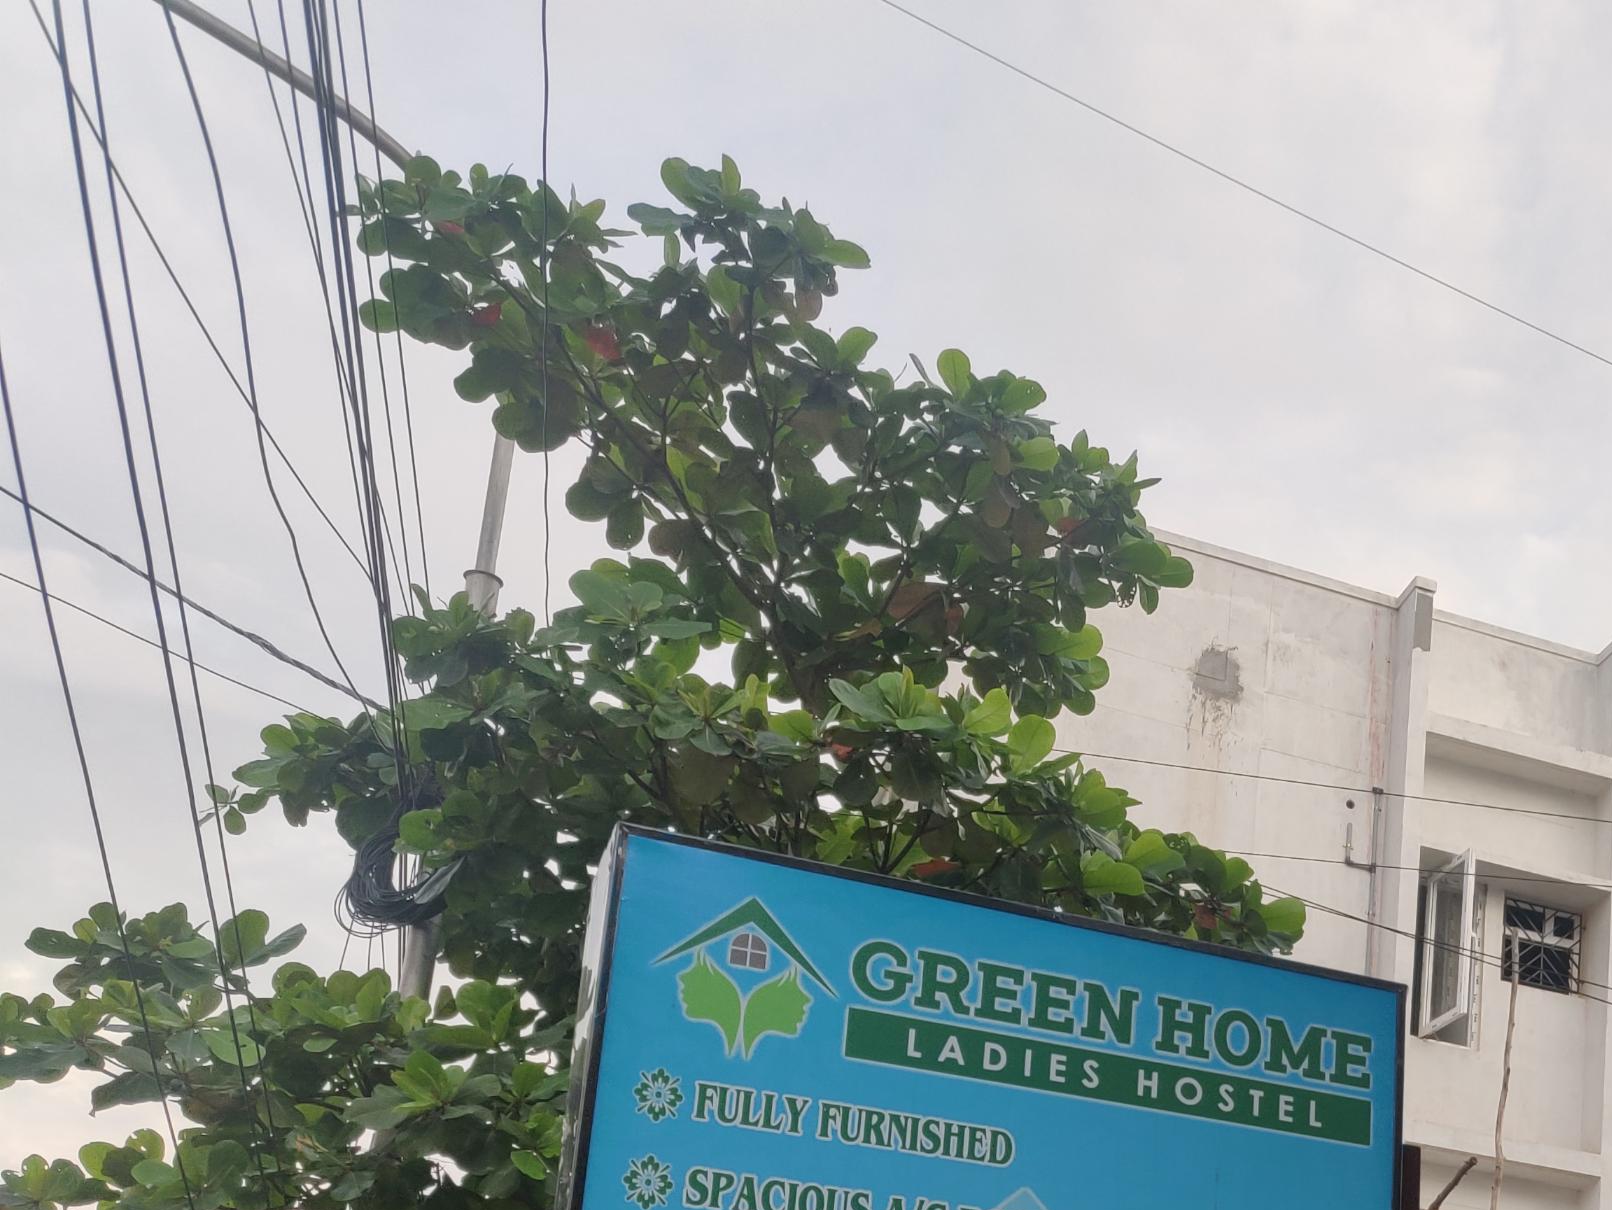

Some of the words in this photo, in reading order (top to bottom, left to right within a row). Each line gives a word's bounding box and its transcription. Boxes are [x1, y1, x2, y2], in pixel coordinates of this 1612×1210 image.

[851, 942, 1139, 1046] GREEN
[1155, 996, 1372, 1090] HOME
[693, 1082, 809, 1135] FULLY
[818, 1102, 1014, 1166] FURNISHED
[906, 1028, 1101, 1089] LADIES
[1136, 1071, 1324, 1129] HOSTEL
